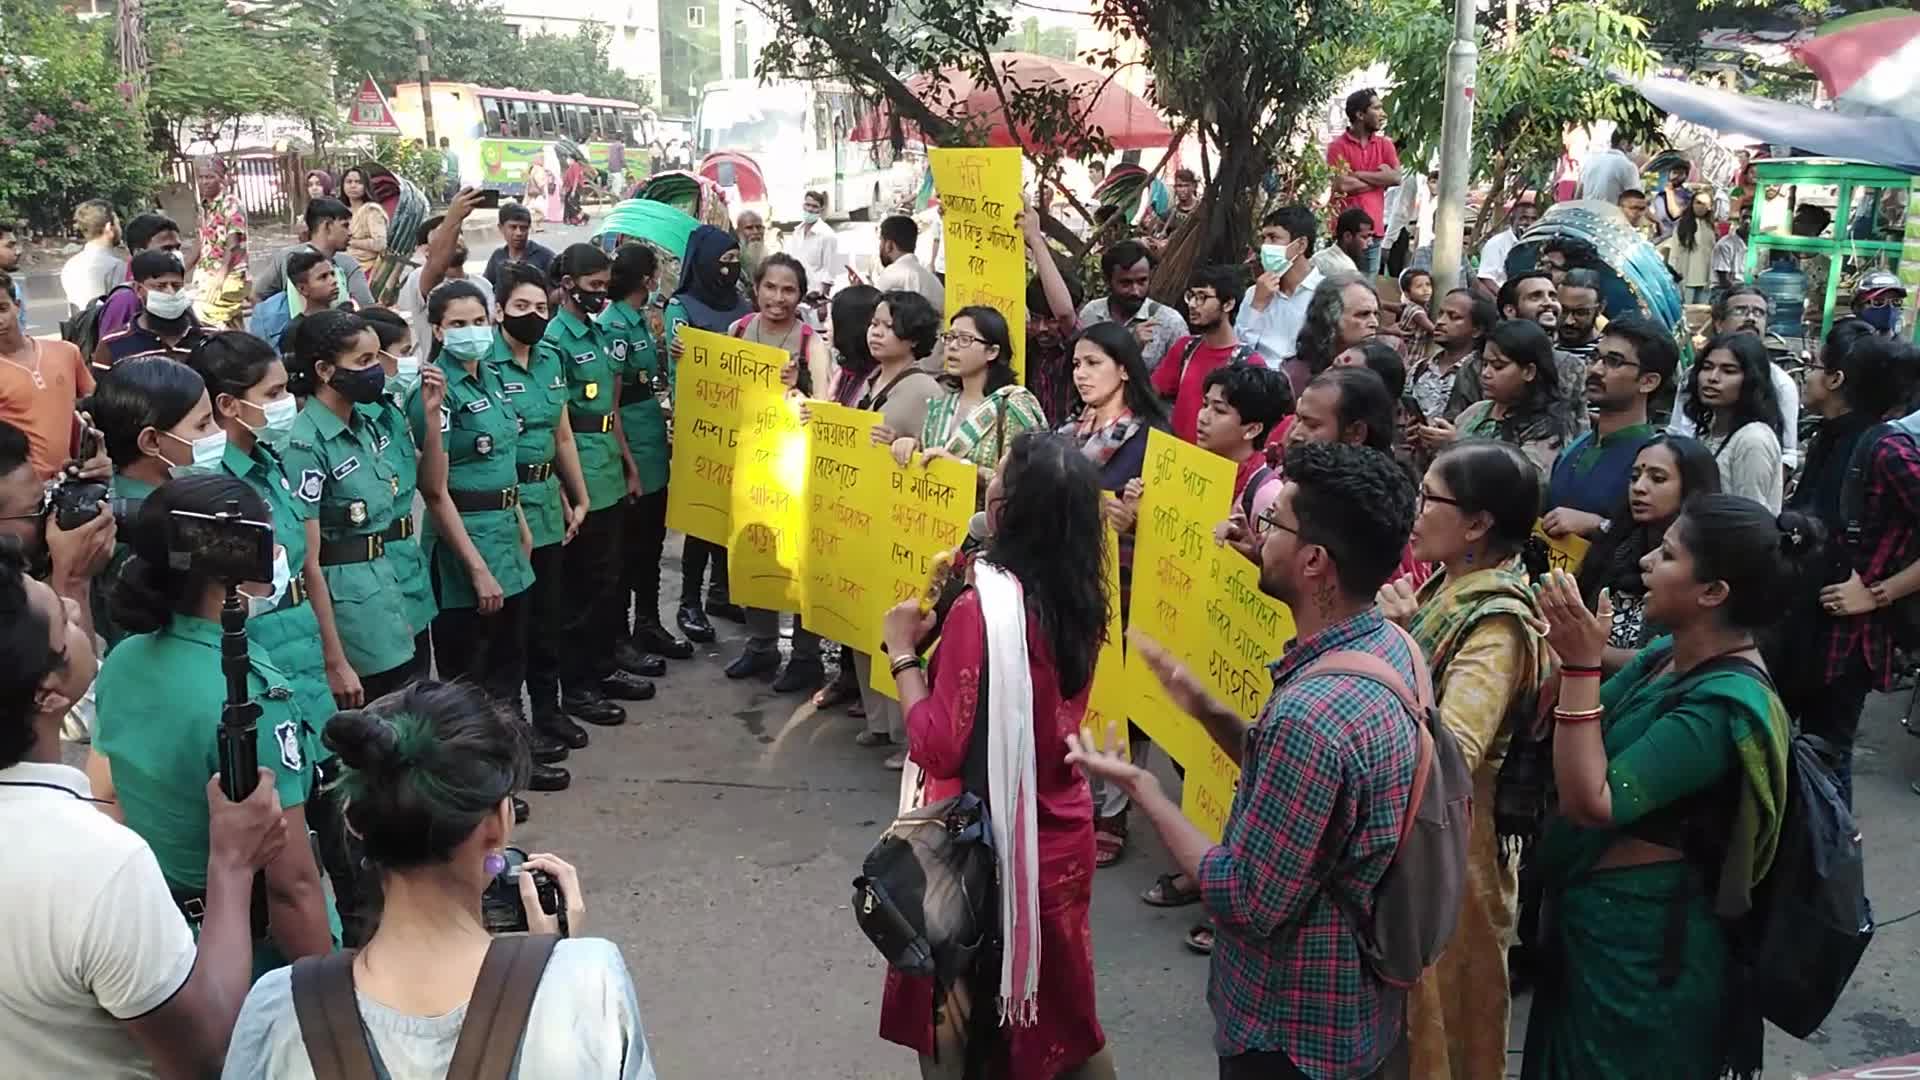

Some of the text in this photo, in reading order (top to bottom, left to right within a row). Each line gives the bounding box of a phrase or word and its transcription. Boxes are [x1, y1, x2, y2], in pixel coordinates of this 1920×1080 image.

[693, 346, 778, 388] চা মালিক
[692, 418, 723, 445] দেশ
[1152, 447, 1177, 486] দুটি
[891, 472, 957, 510] চা মালিক
[891, 542, 914, 573] দেশ
[1209, 649, 1262, 720] সংহতি
